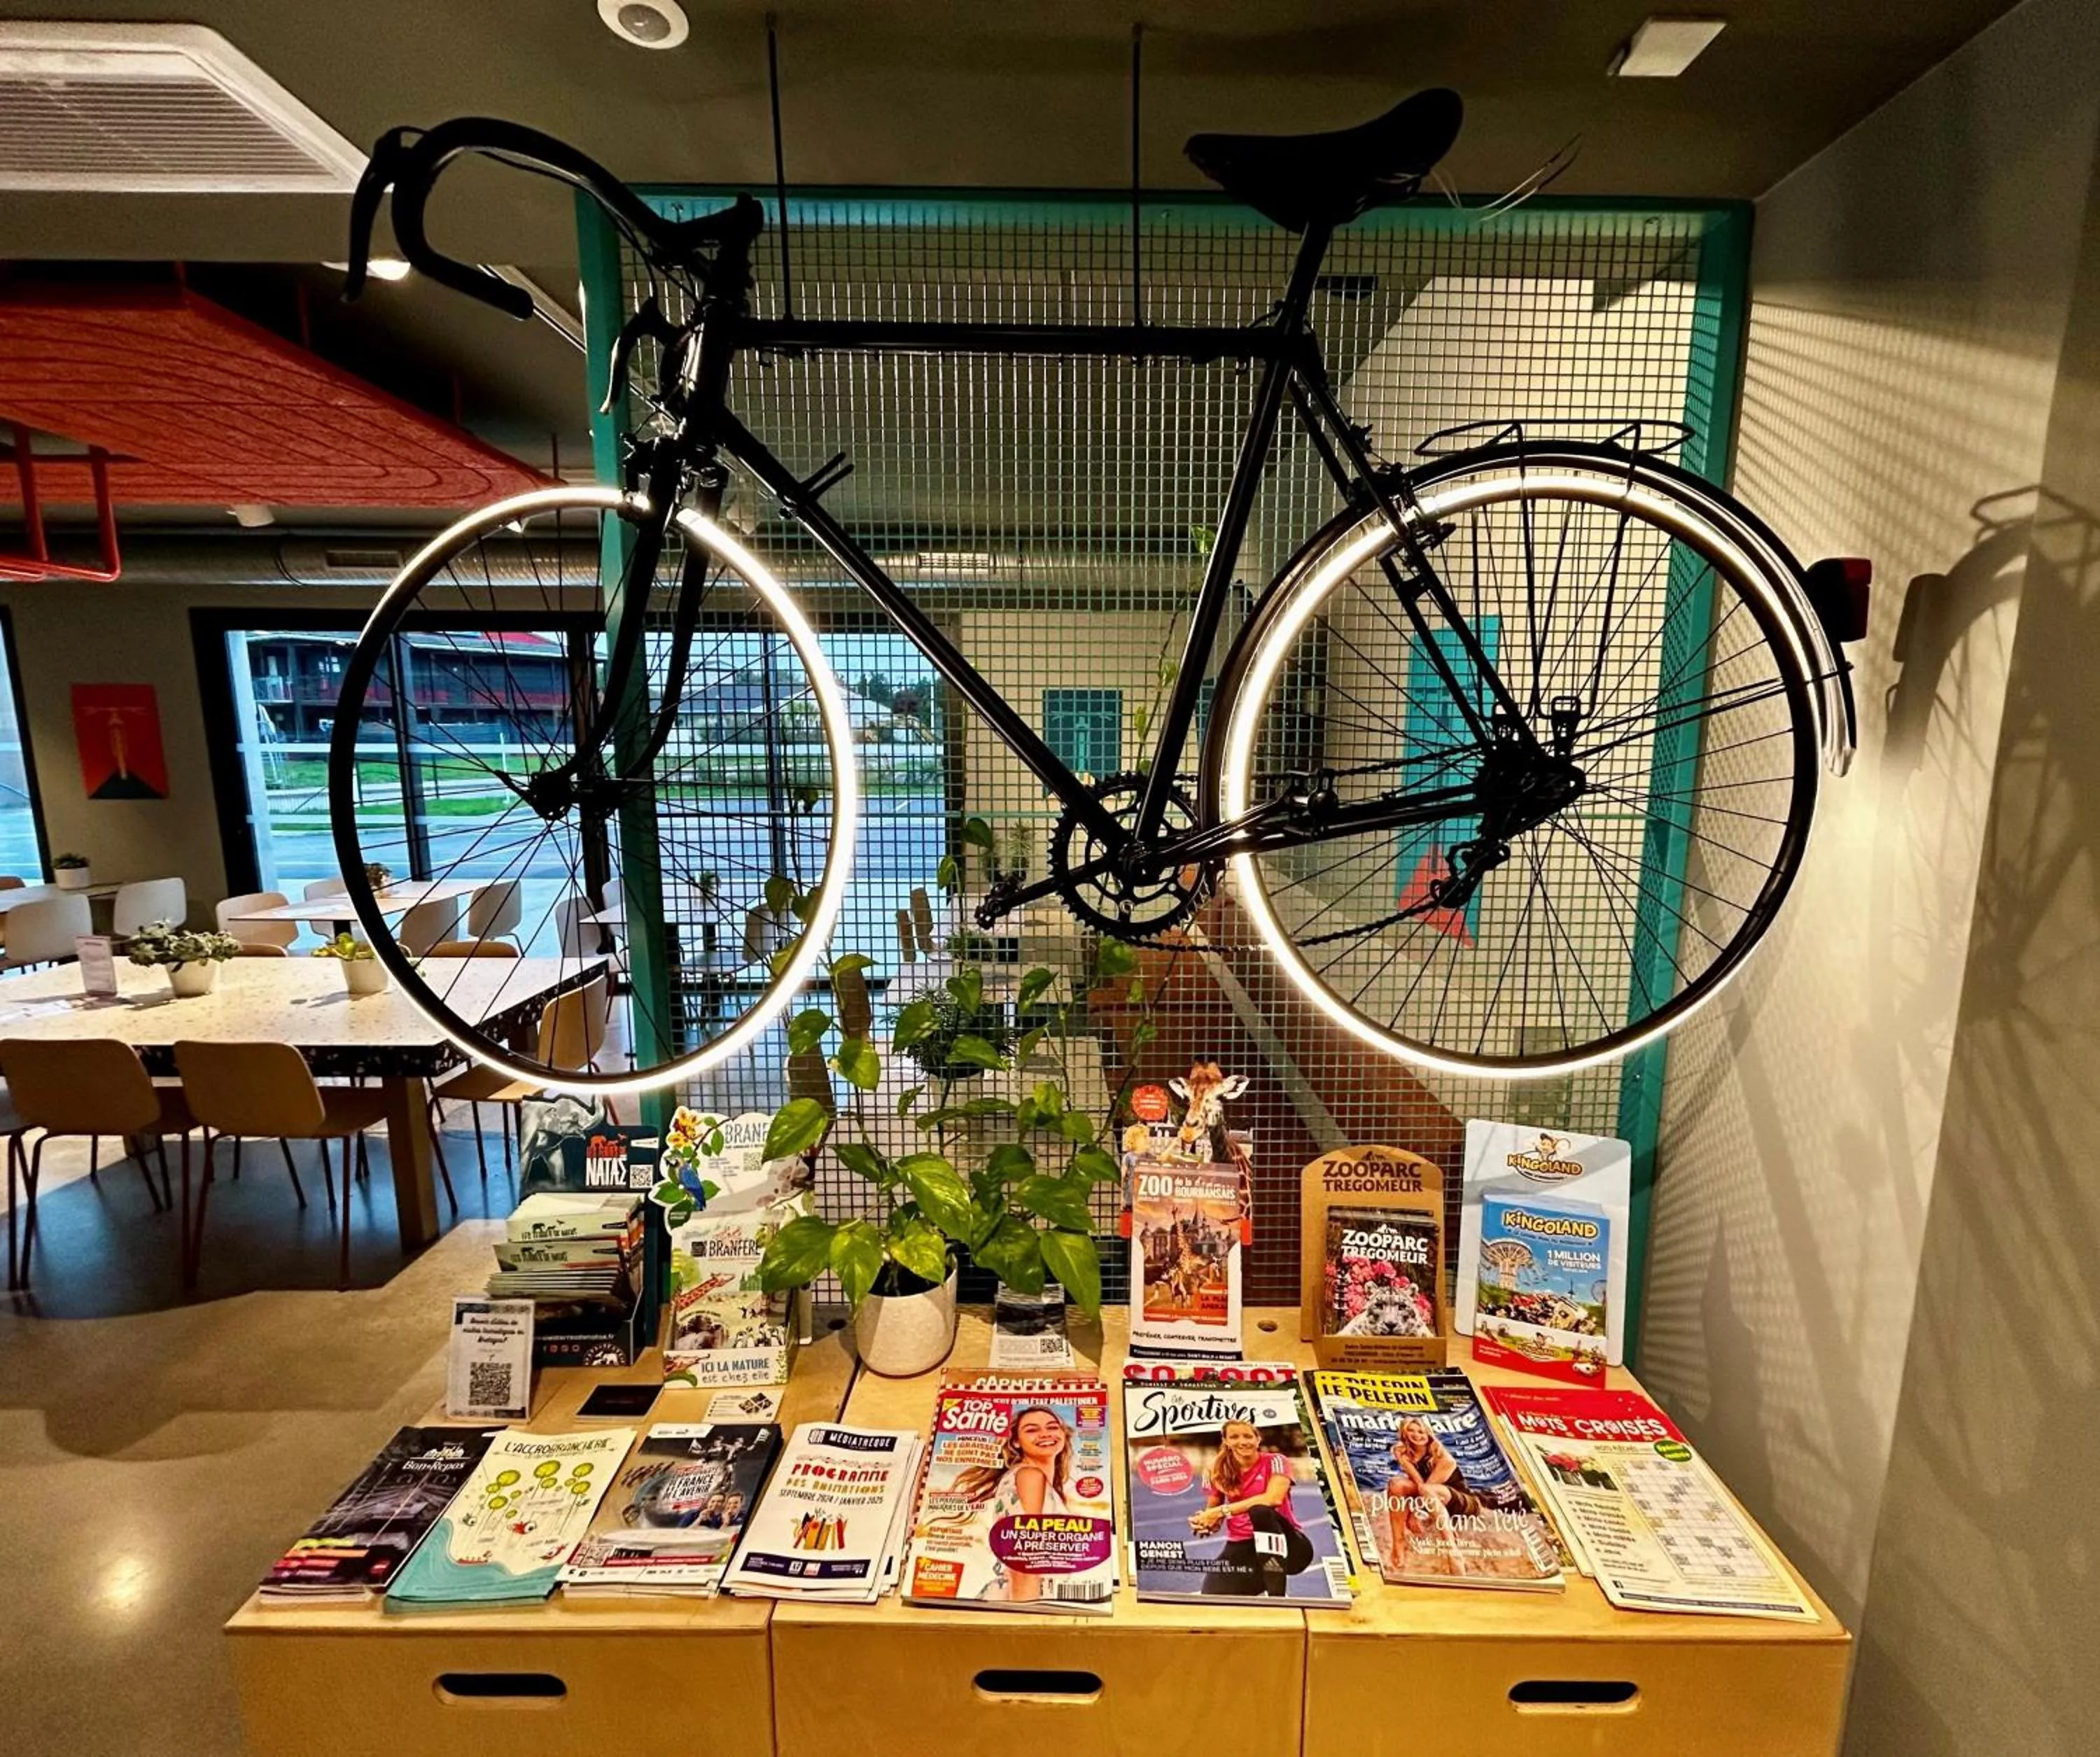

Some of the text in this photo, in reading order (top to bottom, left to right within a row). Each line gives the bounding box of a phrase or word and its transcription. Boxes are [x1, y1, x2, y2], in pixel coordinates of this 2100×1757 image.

[724, 1122, 771, 1144] BRANF
[1322, 1160, 1422, 1178] ZOOPARC
[1507, 1154, 1583, 1175] KINGOLAND
[1138, 1175, 1172, 1196] ZOO
[1322, 1179, 1423, 1192] TREGOMEUR
[1504, 1211, 1598, 1238] KINGOLAND
[1342, 1228, 1429, 1252] ZOOPARC
[1341, 1246, 1428, 1265] TREGOMEUR
[1553, 1250, 1601, 1262] MILLION
[701, 1358, 769, 1373] ICI LA NATURE
[1322, 1384, 1343, 1396] LE
[1346, 1386, 1429, 1405] PELERIN
[963, 1400, 993, 1412] TOP
[1134, 1391, 1256, 1434] Sportives
[943, 1407, 1008, 1434] Santé
[1422, 1413, 1477, 1433] laire
[1518, 1413, 1669, 1436] MOTS CROISÉS
[1525, 1426, 1655, 1441] MAGAZIN
[791, 1463, 890, 1482] PROGRAMME
[1015, 1516, 1093, 1532] LA PEAU
[1000, 1529, 1105, 1542] UN SUPER ORGANE
[1024, 1539, 1090, 1552] PRÉSERVER
[1139, 1541, 1182, 1550] MANON
[1140, 1550, 1184, 1559] GENEST
